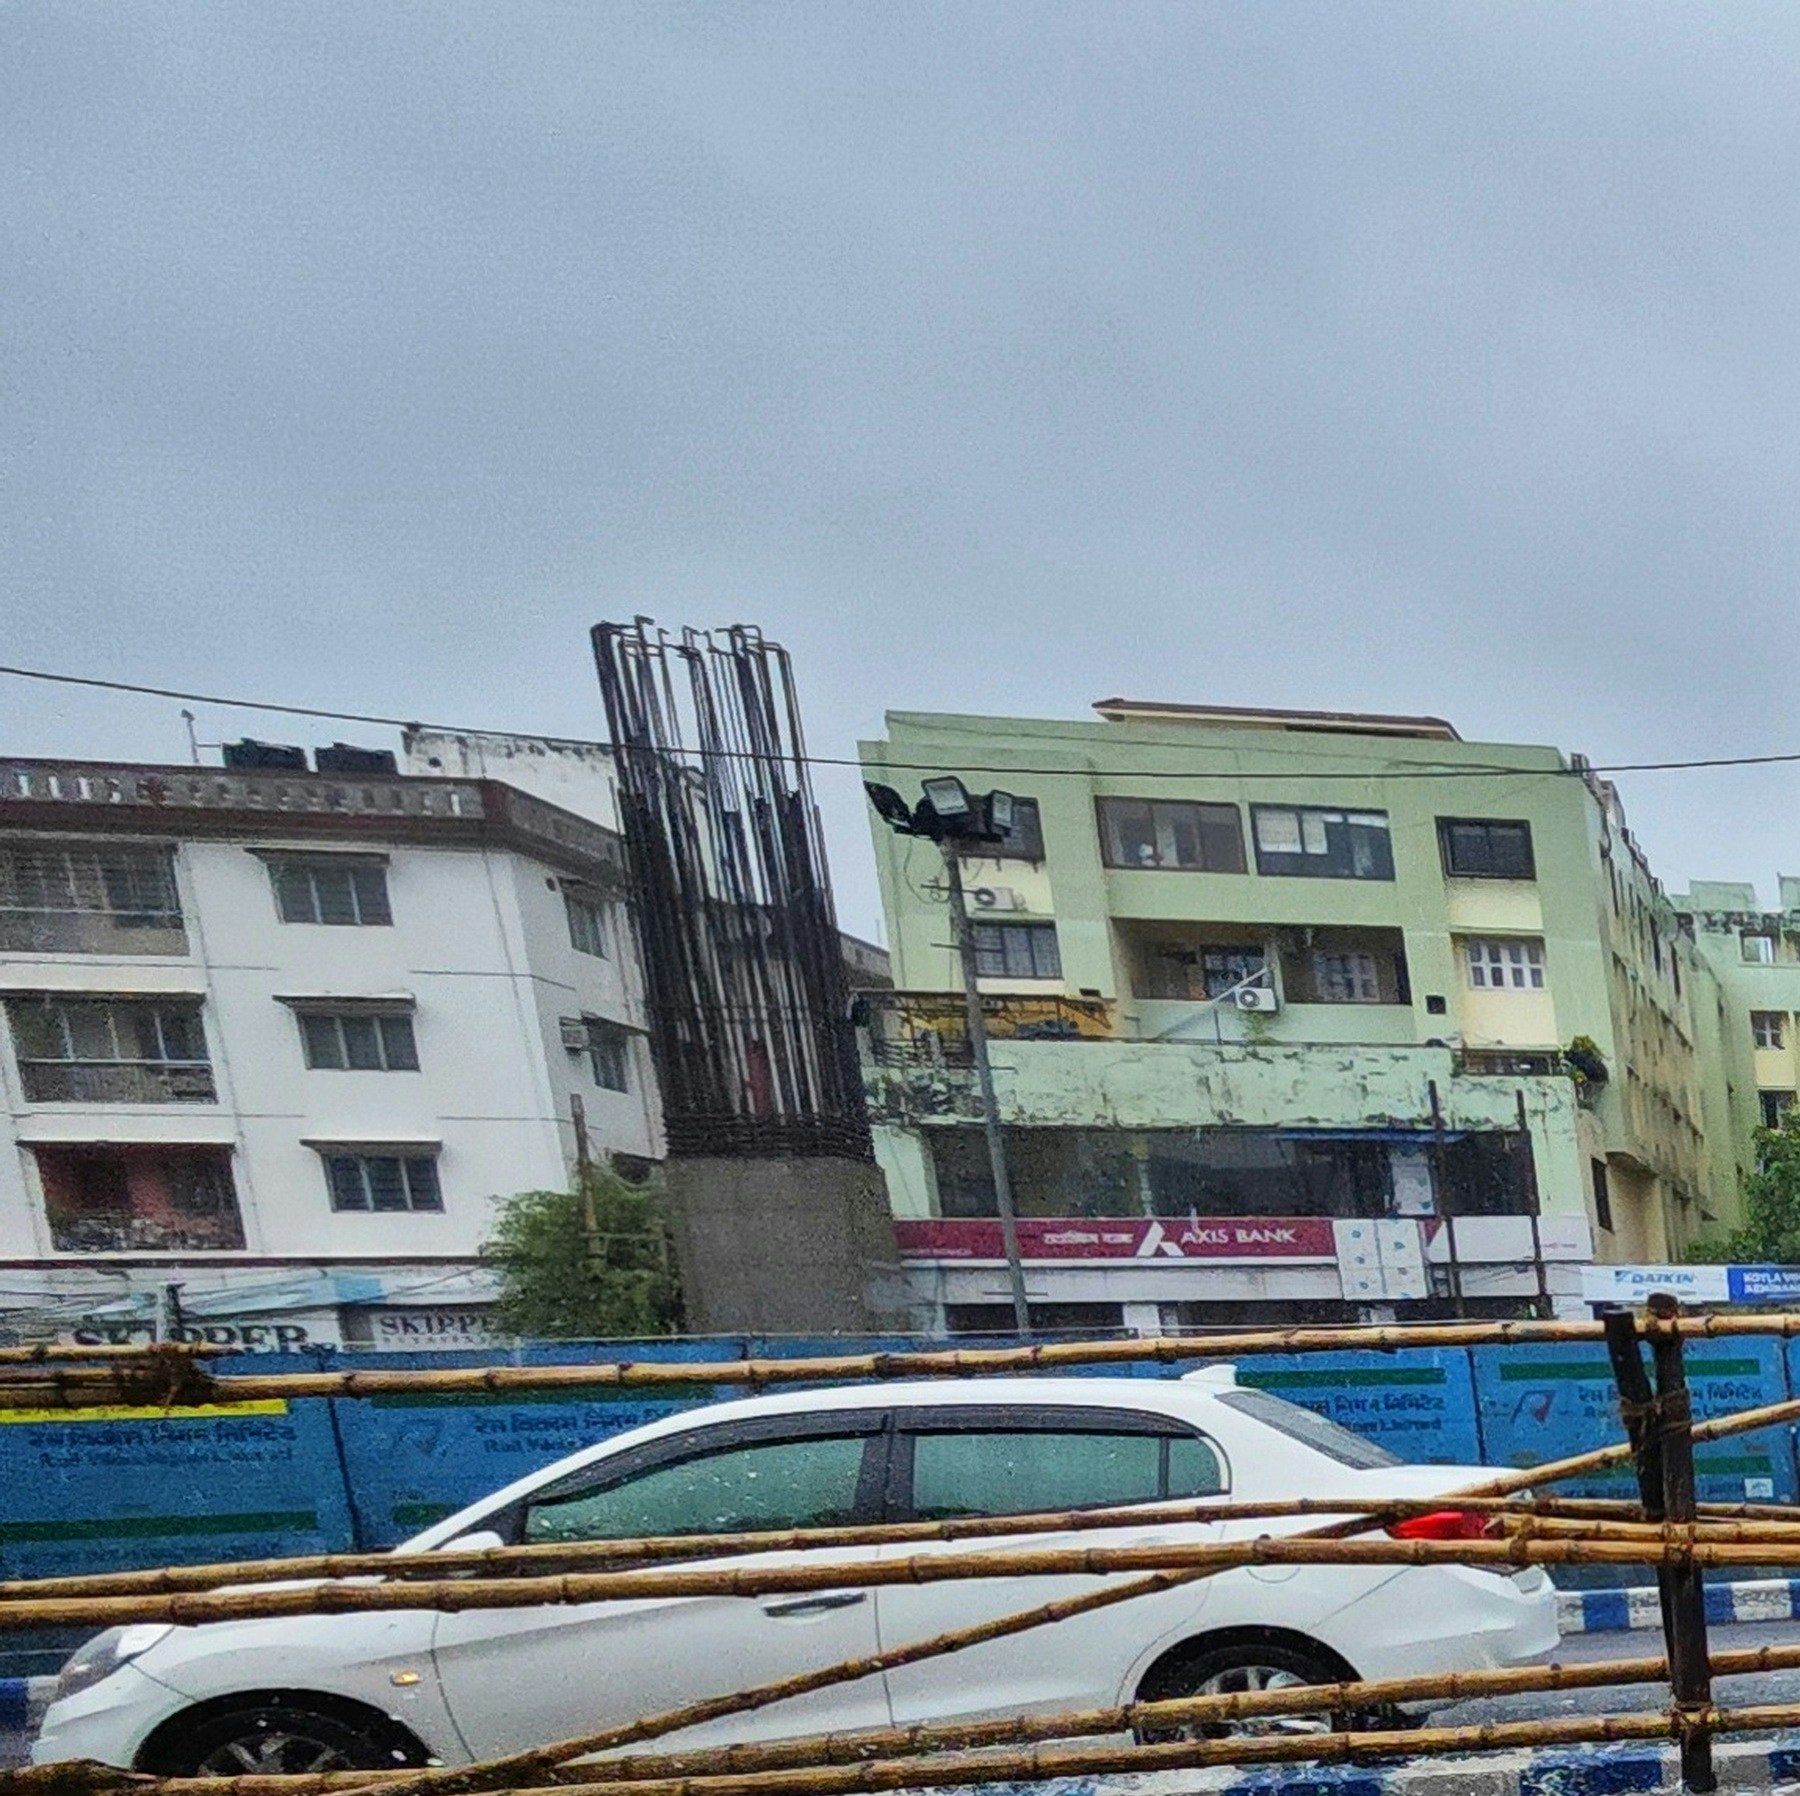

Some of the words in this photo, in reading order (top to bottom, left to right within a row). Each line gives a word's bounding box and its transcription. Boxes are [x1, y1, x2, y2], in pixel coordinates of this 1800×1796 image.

[1181, 1227, 1229, 1244] AXIS
[1234, 1227, 1297, 1243] BANK
[380, 1315, 498, 1336] SKIPPE
